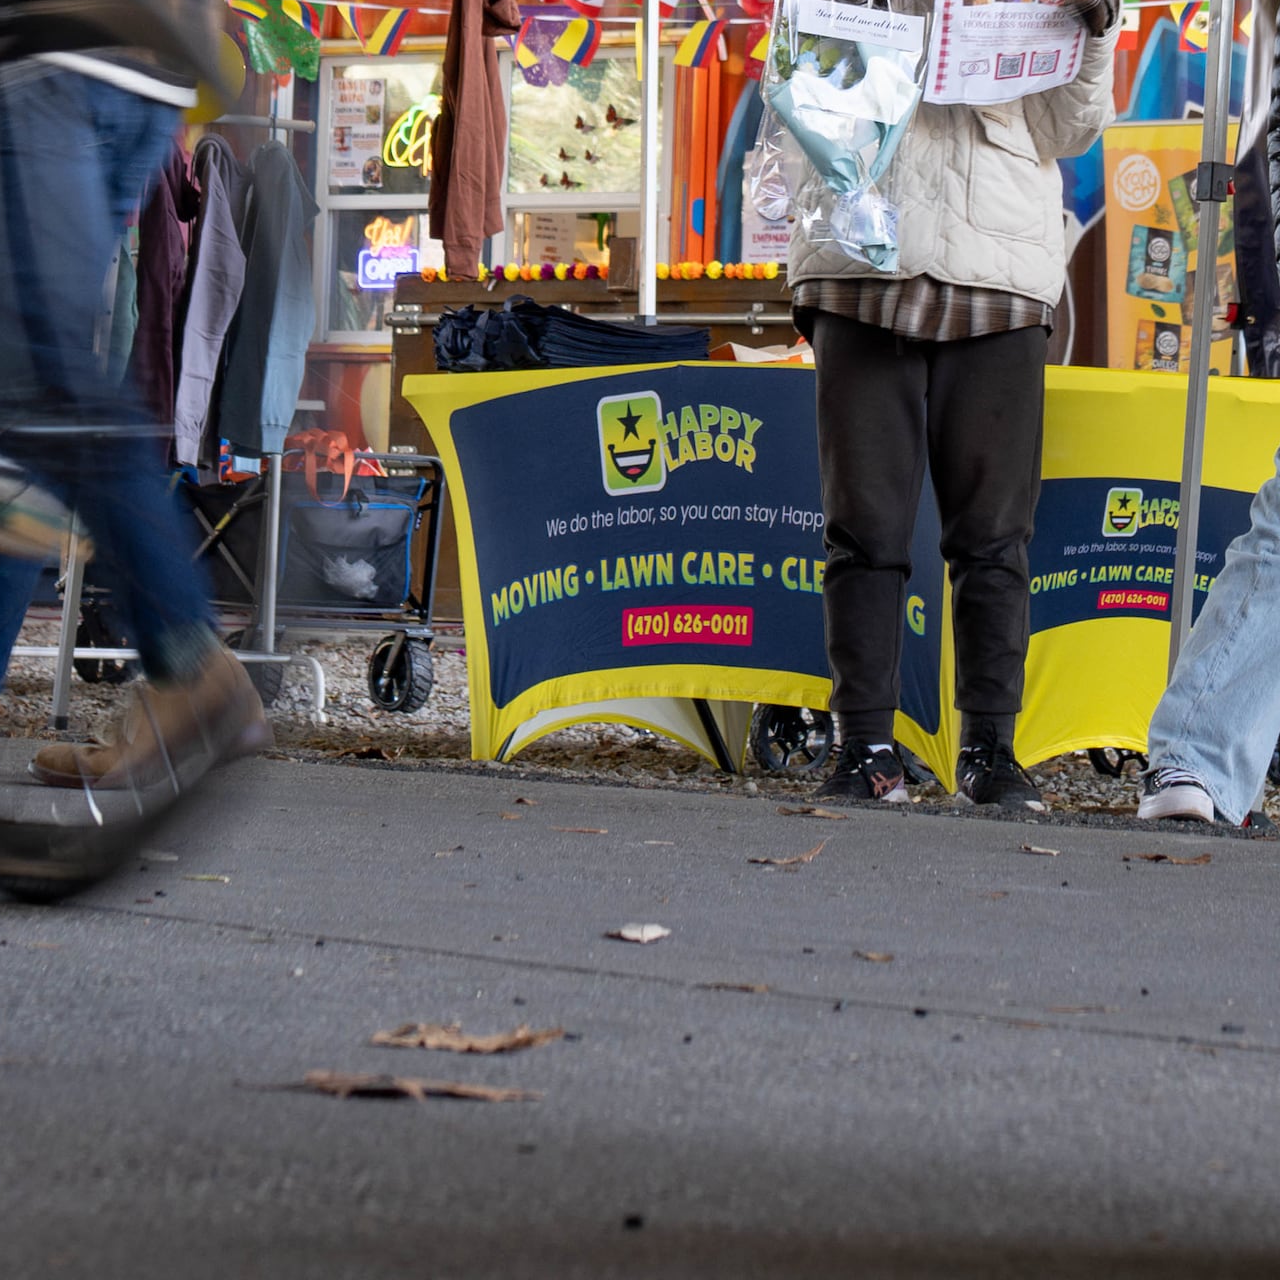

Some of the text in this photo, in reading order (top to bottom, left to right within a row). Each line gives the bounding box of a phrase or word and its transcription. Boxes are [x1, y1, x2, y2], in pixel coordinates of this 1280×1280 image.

[836, 11, 858, 23] had
[963, 20, 1065, 29] HOMELESS SHELTERS
[994, 11, 1032, 19] PROFITS
[1035, 11, 1049, 19] GO
[1052, 11, 1065, 19] TO
[656, 404, 764, 444] HAPPY
[663, 431, 757, 474] LABOR
[1138, 498, 1180, 514] HAPP
[546, 504, 824, 537] We do the labor, so you can stay Happ
[1064, 545, 1078, 556] We
[1078, 543, 1089, 555] do
[1090, 542, 1104, 553] the
[1105, 541, 1127, 553] labor,
[1129, 543, 1138, 552] so
[1139, 543, 1154, 554] you
[1156, 545, 1171, 554] can
[1194, 550, 1218, 563] appy!
[491, 564, 580, 627] MOVING
[600, 552, 674, 591] LAWN
[681, 551, 755, 586] CARE
[1029, 568, 1078, 595] OVING
[1090, 565, 1132, 584] LAWN
[1135, 565, 1174, 585] CARE
[1101, 591, 1167, 607] (470) 626-0011
[627, 611, 748, 640] (470) 626-0011
